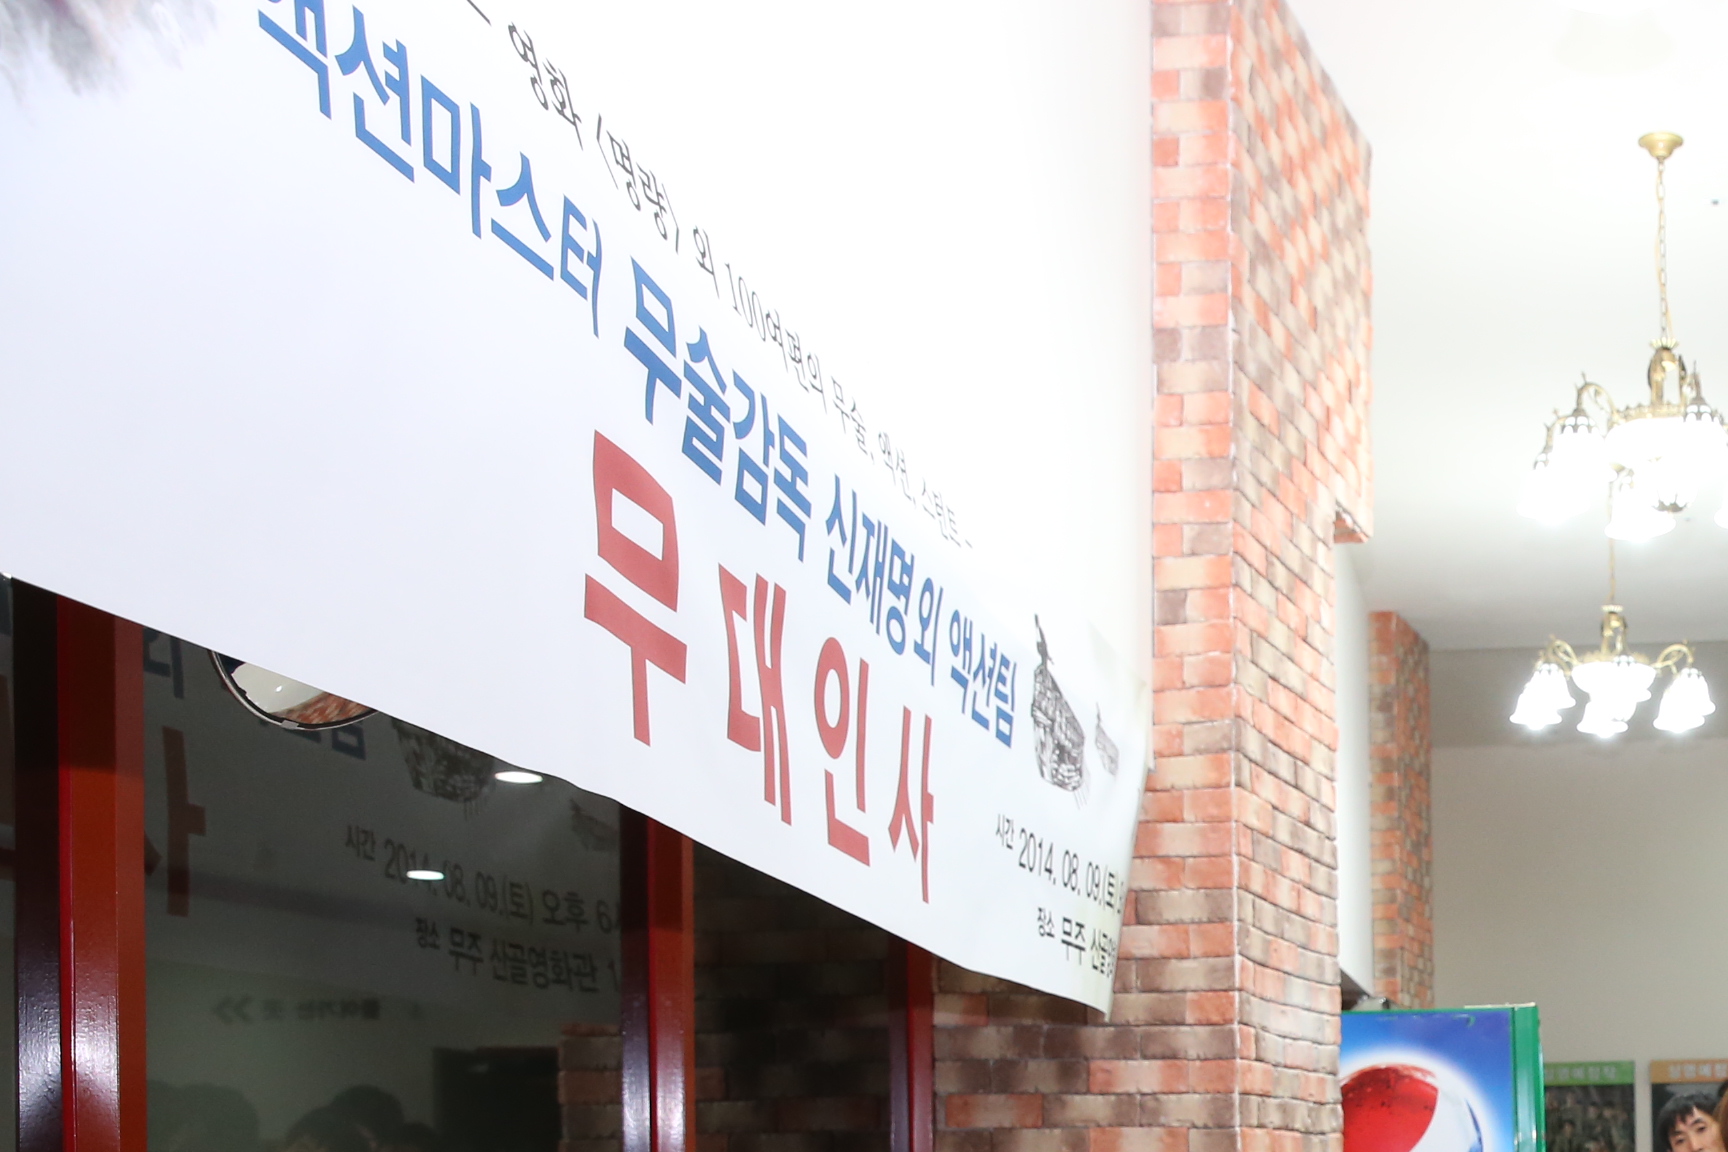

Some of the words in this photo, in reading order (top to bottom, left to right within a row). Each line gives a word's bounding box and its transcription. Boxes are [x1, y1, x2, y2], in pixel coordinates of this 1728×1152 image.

[508, 22, 583, 151] 영화
[624, 255, 813, 563] 무술감독
[825, 472, 915, 656] 신재명
[949, 609, 1017, 749] 액션팀
[996, 813, 1015, 850] 시간
[1060, 916, 1087, 966] 무주
